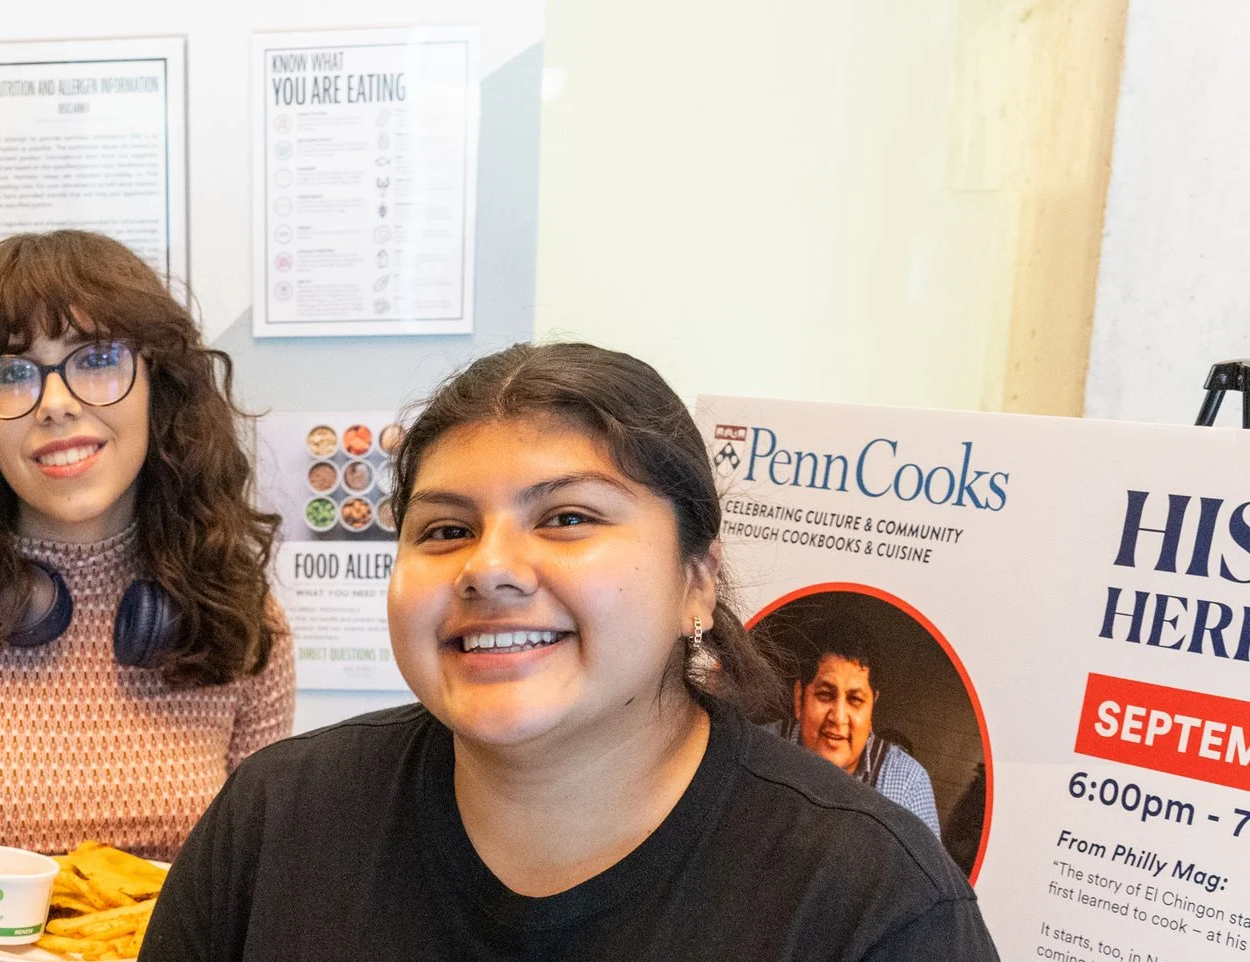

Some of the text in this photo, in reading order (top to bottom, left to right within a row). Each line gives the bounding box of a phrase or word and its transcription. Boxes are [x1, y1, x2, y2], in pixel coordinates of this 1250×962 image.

[272, 52, 344, 73] KNOW WHAT
[272, 73, 406, 106] YOU ARE EATING
[722, 520, 932, 563] THROUGH COOKBOOKS & CUISINE
[725, 500, 964, 544] CELEBRATING CULTURE & COMMUNITY
[295, 554, 392, 579] FOOD ALLER
[1068, 772, 1195, 825] 6:00pm
[1232, 808, 1250, 838] 7
[1057, 830, 1228, 892] From Philly Mag:
[1049, 881, 1075, 900] first
[1078, 890, 1129, 916] learned
[1133, 907, 1147, 921] to
[1152, 915, 1187, 933] cook
[1207, 929, 1221, 943] at
[1226, 932, 1247, 951] his
[1087, 873, 1122, 893] story
[1126, 884, 1141, 896] of
[1145, 886, 1157, 902] El
[1162, 891, 1224, 920] Chingon
[1041, 922, 1050, 936] It
[1053, 929, 1093, 951] starts,
[1098, 941, 1124, 960] too,
